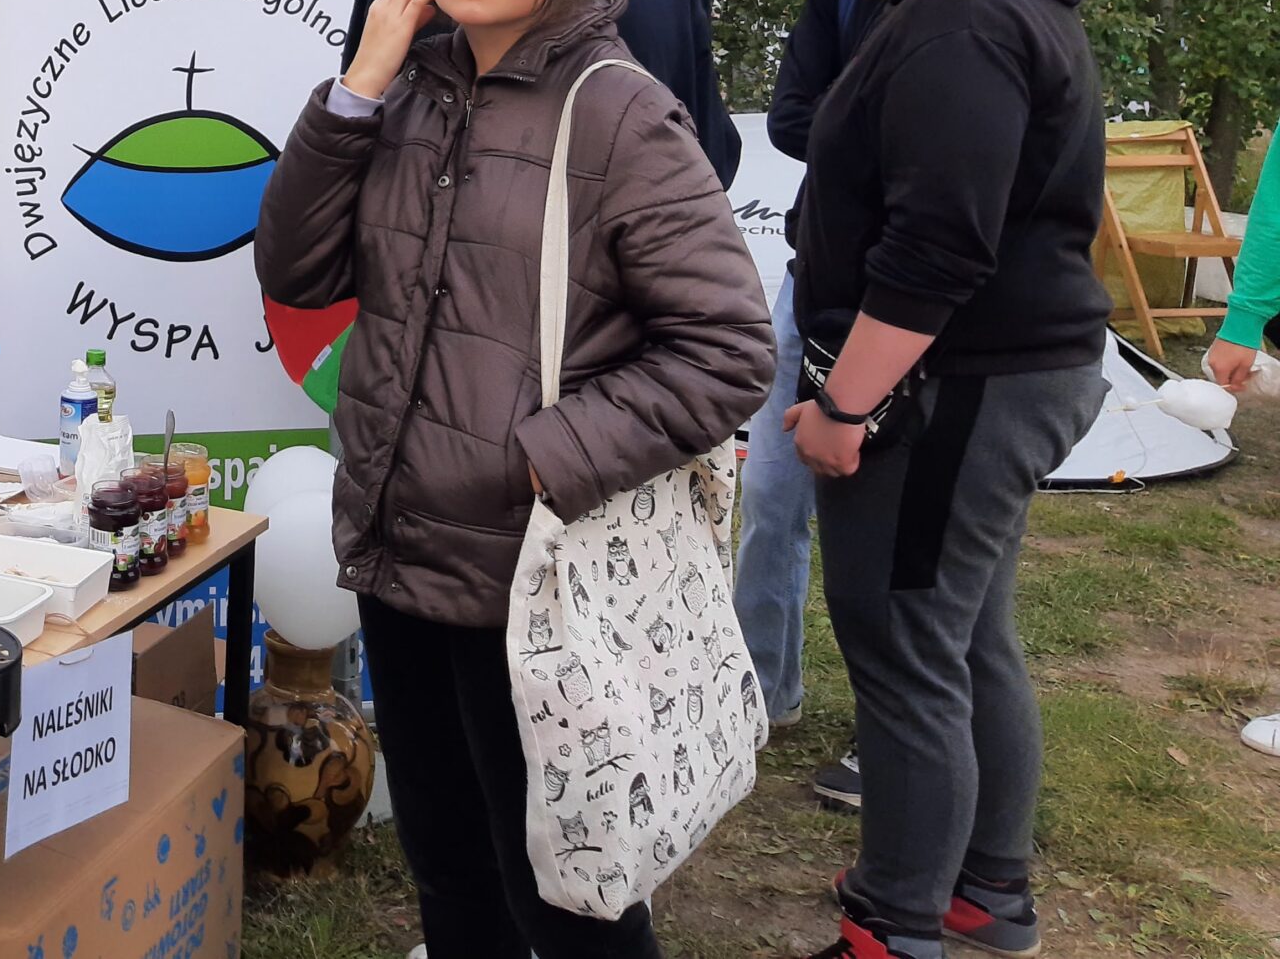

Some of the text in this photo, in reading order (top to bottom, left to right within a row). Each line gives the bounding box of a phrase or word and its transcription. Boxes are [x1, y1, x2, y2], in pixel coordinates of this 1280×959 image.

[5, 22, 91, 260] Dwujęzyczne
[67, 281, 220, 361] WYSPA
[32, 685, 113, 741] NALEŚNIKI
[530, 699, 554, 723] owl
[23, 766, 47, 800] NA
[51, 736, 116, 787] SŁODKO
[586, 780, 615, 802] hello
